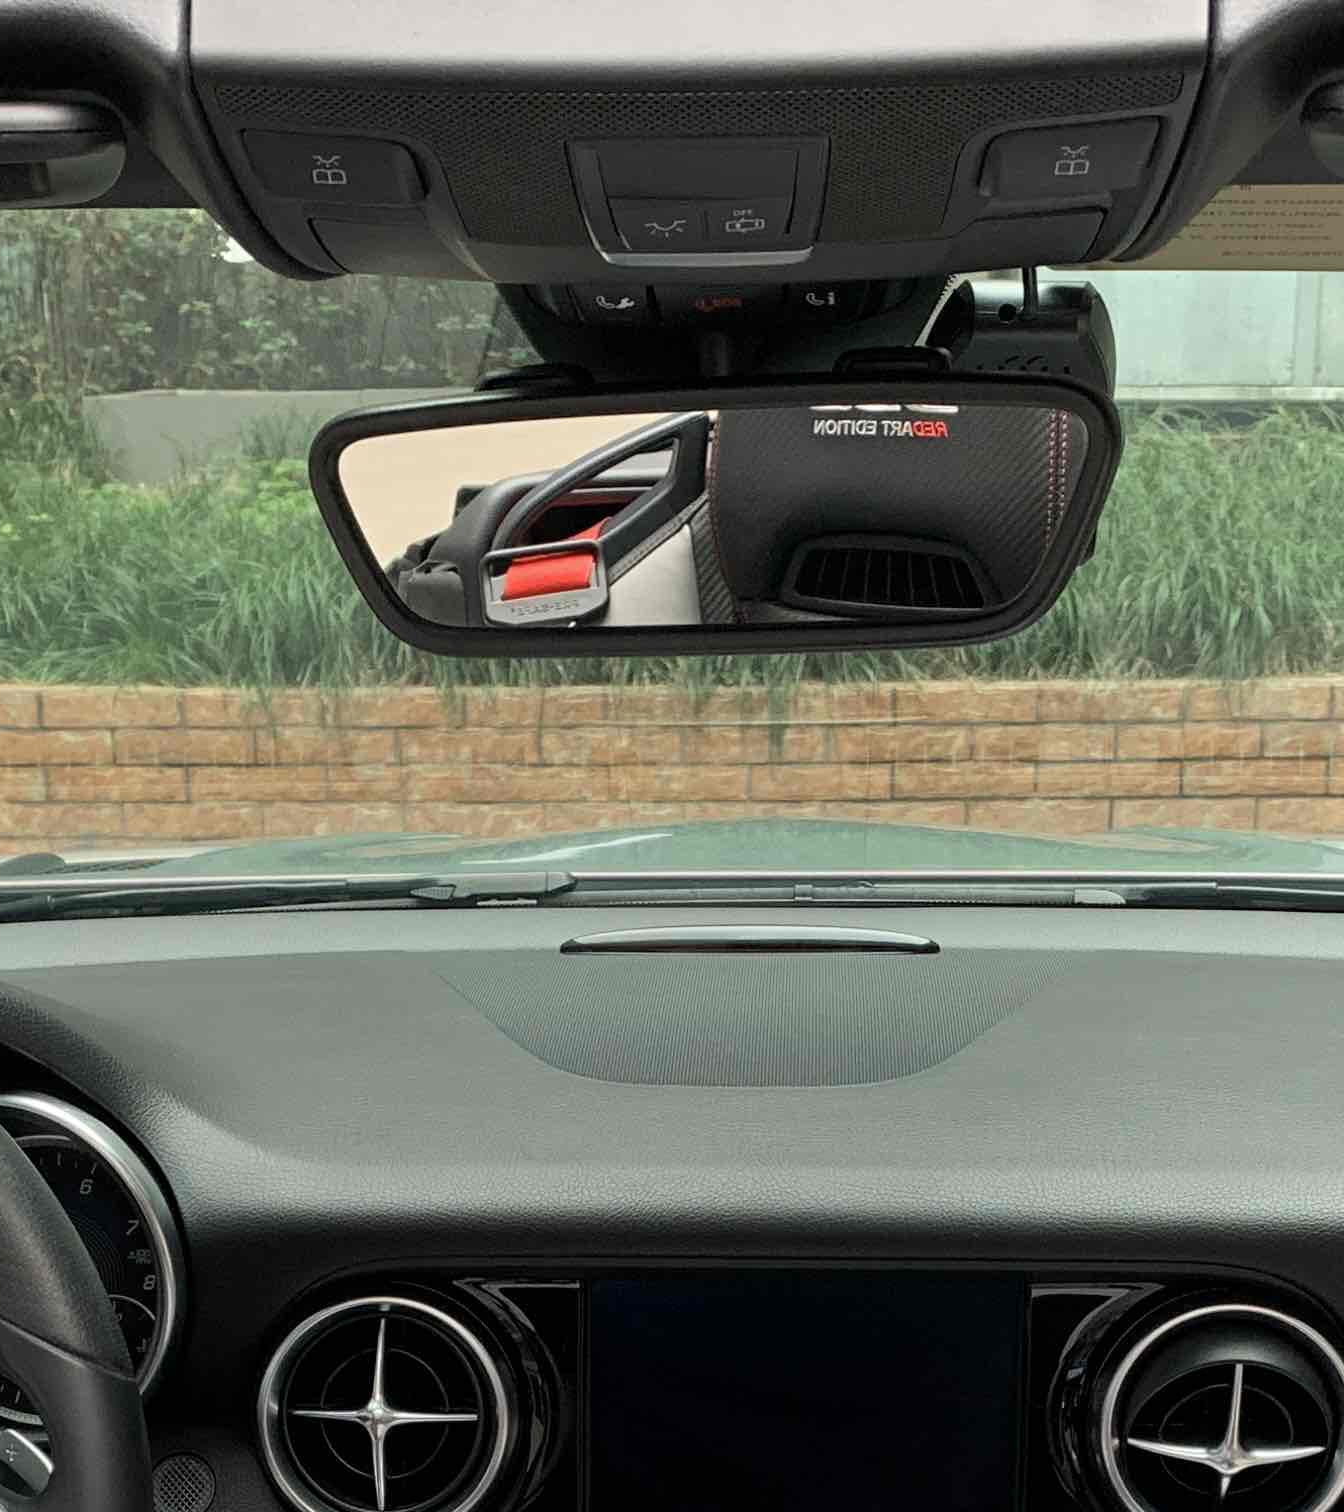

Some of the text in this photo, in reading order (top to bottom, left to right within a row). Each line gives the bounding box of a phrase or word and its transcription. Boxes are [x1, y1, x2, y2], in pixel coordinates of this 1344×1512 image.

[80, 1178, 94, 1194] 6
[126, 1219, 139, 1235] 7
[143, 1274, 156, 1290] 8
